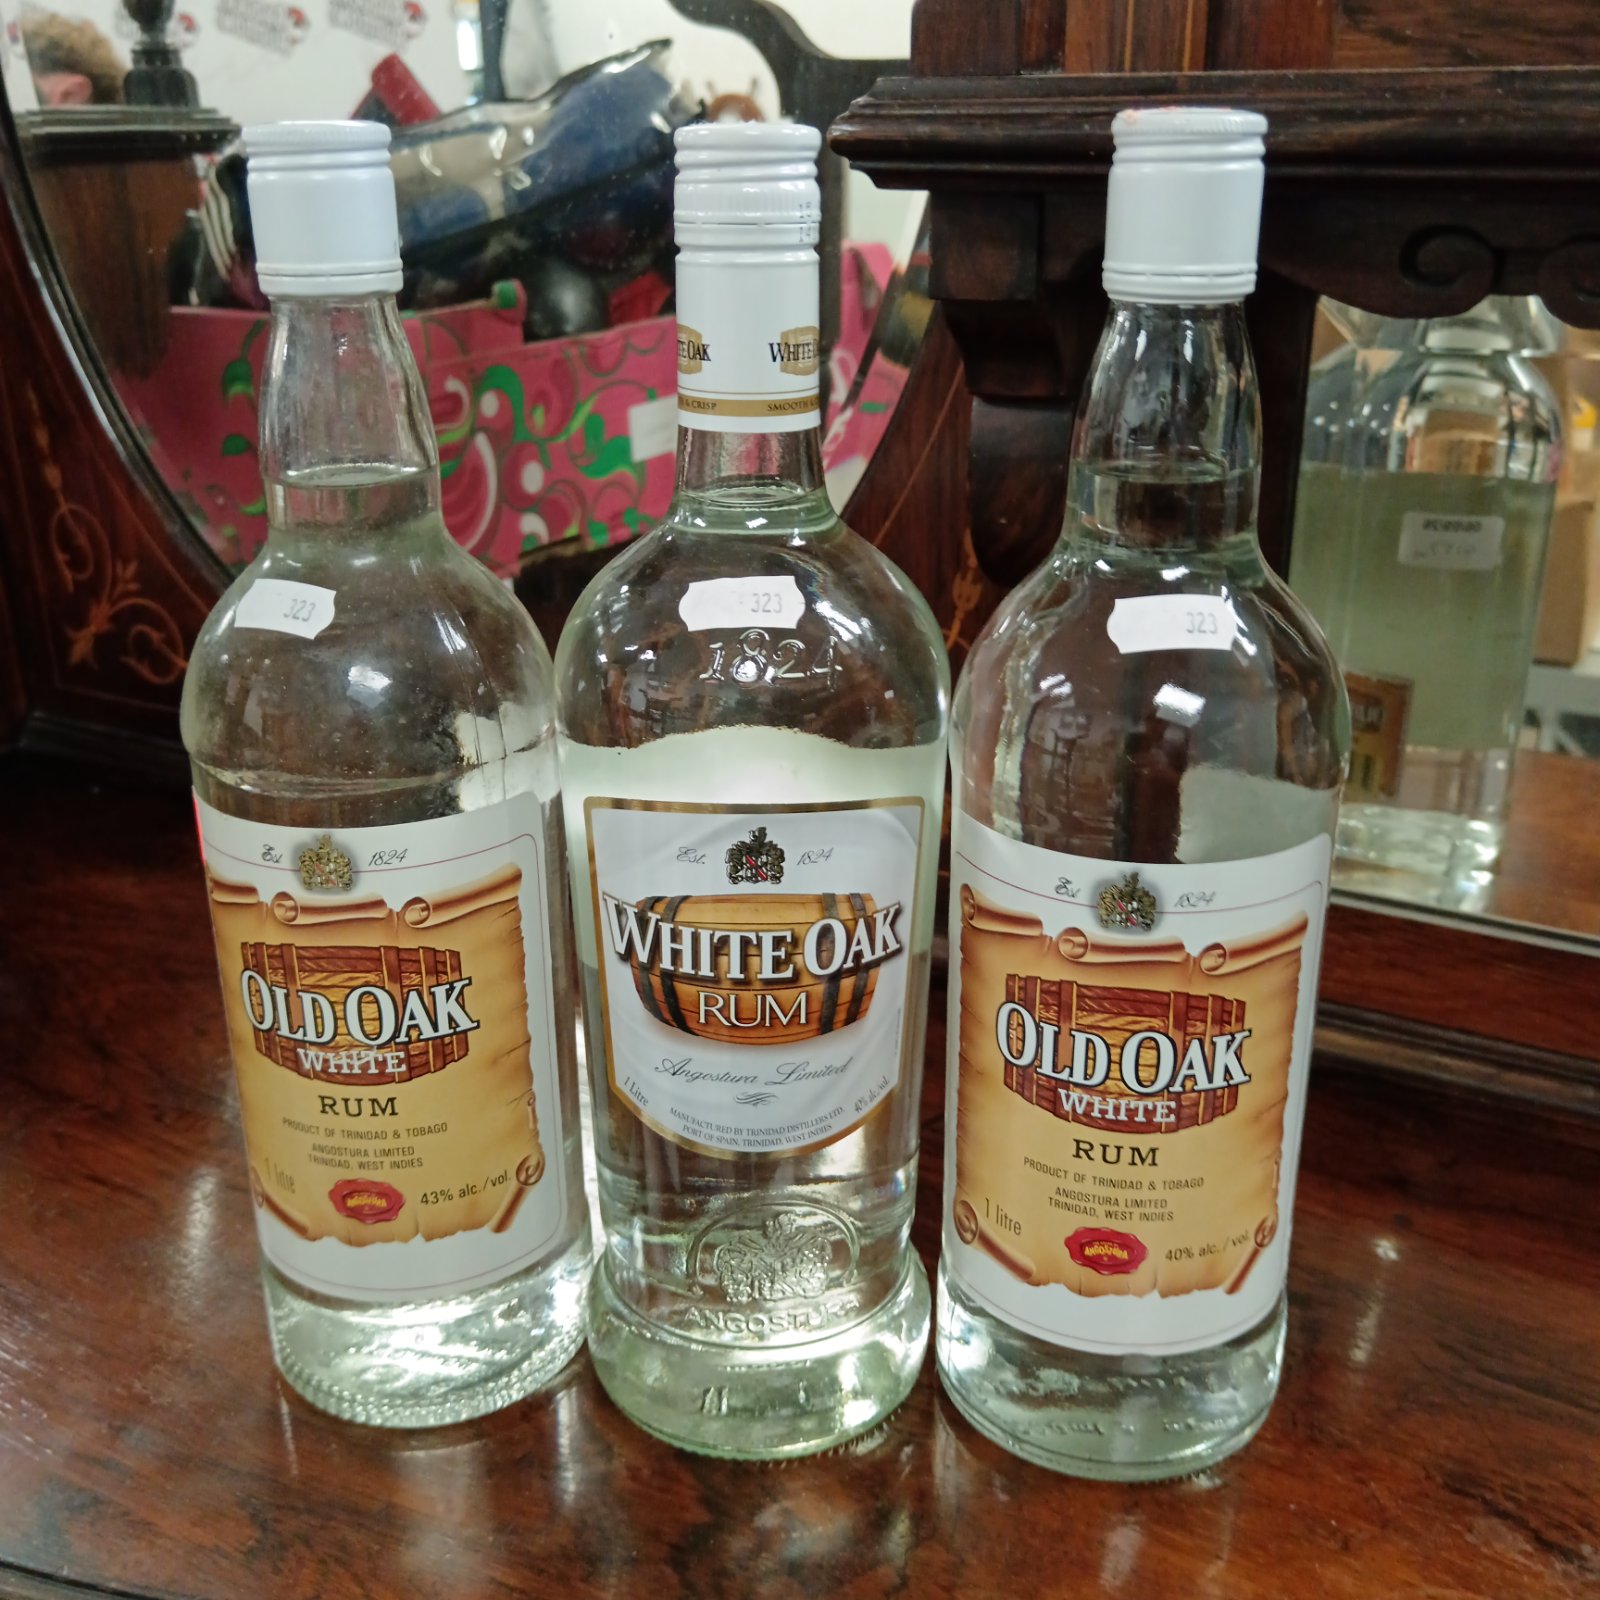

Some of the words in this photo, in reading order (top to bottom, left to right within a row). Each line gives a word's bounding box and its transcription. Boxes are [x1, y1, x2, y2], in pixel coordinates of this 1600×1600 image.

[687, 340, 711, 361] OAK
[768, 339, 813, 362] WHITE
[691, 401, 717, 410] CRISP
[283, 598, 316, 622] 323
[751, 593, 783, 613] 323
[1186, 612, 1217, 634] 323
[700, 628, 843, 692] 1824
[369, 848, 408, 866] 1824
[797, 848, 834, 865] 1824
[602, 891, 795, 981] WHITE
[803, 902, 902, 977] OAK
[241, 969, 337, 1045] OLD
[344, 976, 480, 1046] OAK
[697, 990, 807, 1028] RUM
[995, 1001, 1111, 1087] OLD
[1120, 1028, 1252, 1096] OAK
[297, 1047, 406, 1074] WHITE
[654, 1058, 758, 1084] Angostura
[764, 1056, 854, 1085] Limited
[318, 1095, 399, 1117] RUM
[1058, 1087, 1176, 1123] WHITE
[281, 1116, 320, 1136] PRODUCT
[325, 1127, 337, 1139] OF
[341, 1129, 388, 1141] TRINIDAD
[392, 1129, 401, 1140] &
[406, 1122, 448, 1138] TOBAGO
[669, 1107, 732, 1134] MANUFACTURED
[734, 1128, 743, 1136] BY
[746, 1127, 786, 1138] TRINIDAD
[786, 1115, 829, 1134] DISTILLERS
[682, 1124, 703, 1138] PORT
[704, 1132, 714, 1142] OF
[785, 1133, 806, 1145] WEST
[807, 1124, 832, 1140] INDIES
[311, 1143, 369, 1158] ANGOSTURA
[374, 1146, 415, 1158] LIMITED
[1072, 1138, 1160, 1166] RUM
[358, 1161, 384, 1171] WEST
[390, 1157, 423, 1169] INDIES
[1023, 1156, 1069, 1180] PRODUCT
[1073, 1172, 1087, 1183] OF
[1092, 1175, 1143, 1190] TRINIDAD
[1148, 1180, 1156, 1190] &
[1162, 1177, 1204, 1190] TOBAGO
[420, 1188, 454, 1206] 43%
[1055, 1186, 1120, 1207] ANGOSTURA
[1124, 1197, 1168, 1209] LIMITED
[985, 1198, 990, 1218] 1
[995, 1204, 1022, 1236] litre
[1104, 1209, 1134, 1221] WEST
[1139, 1210, 1174, 1222] INDIES
[1165, 1246, 1194, 1262] 40%
